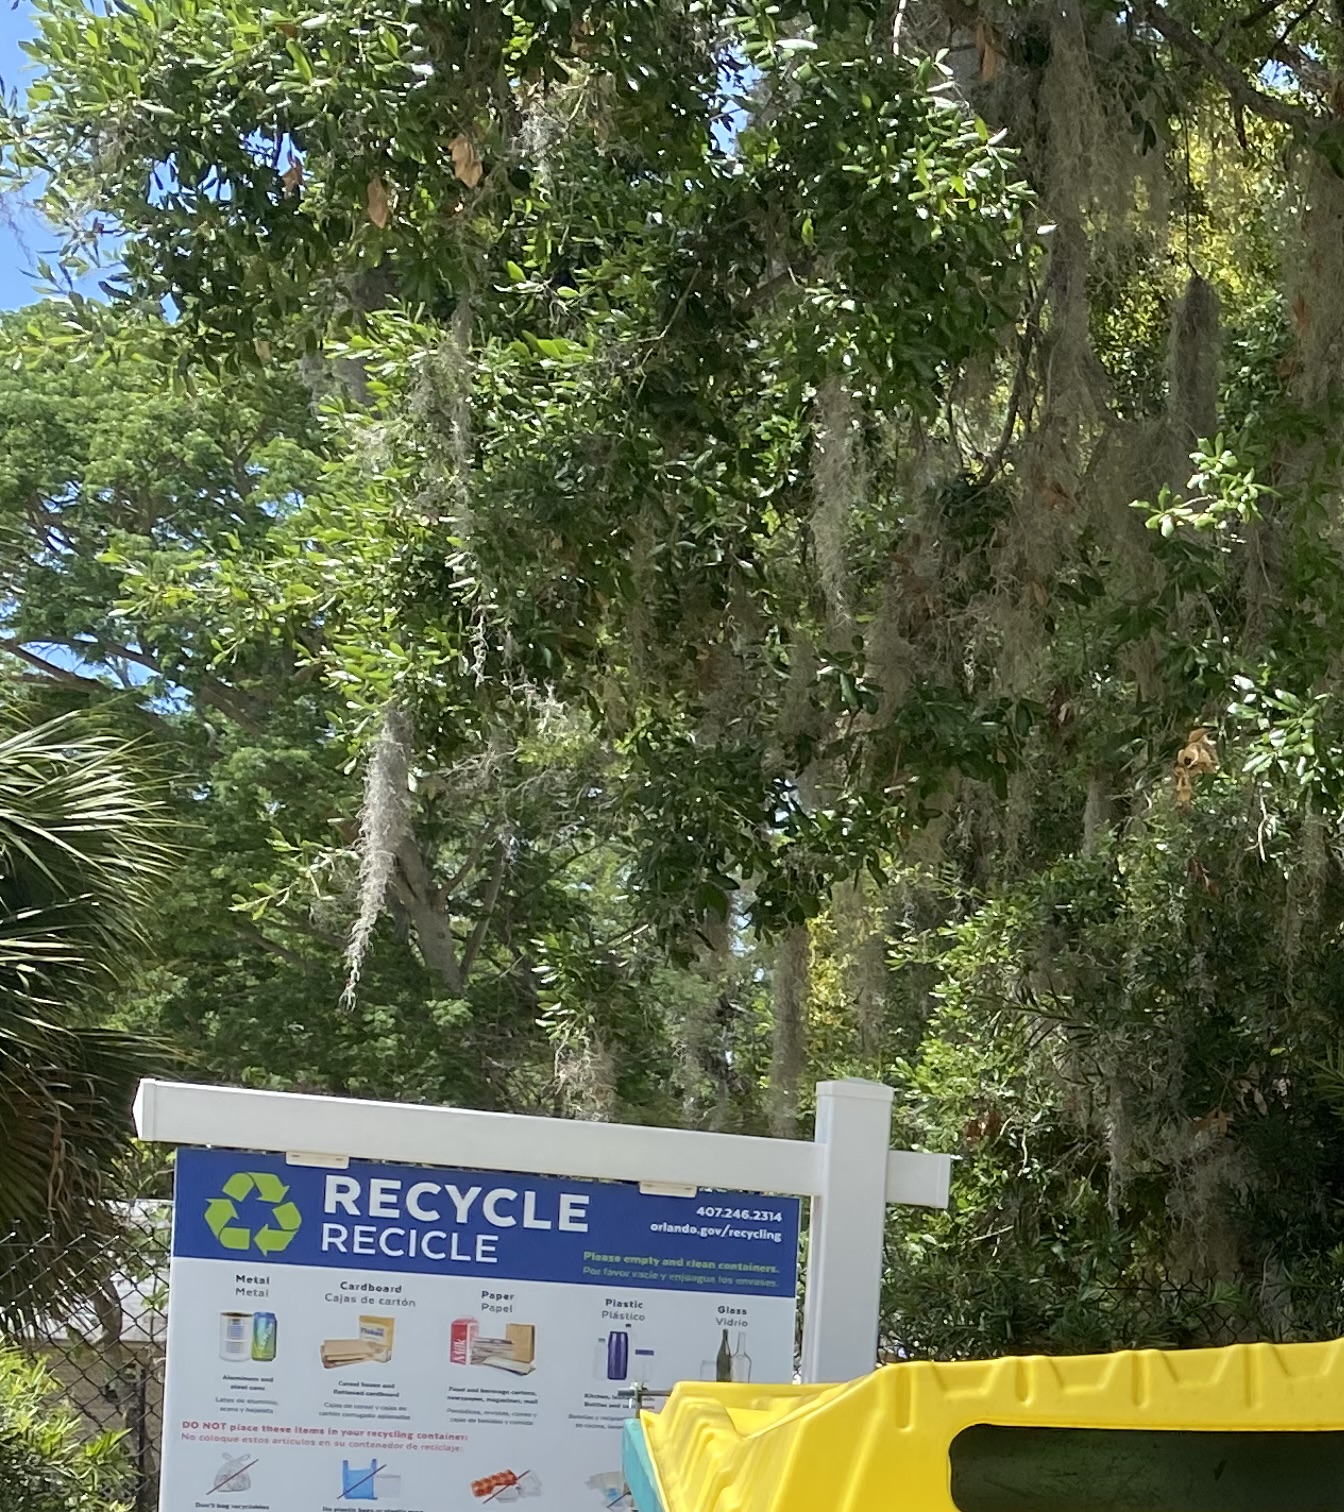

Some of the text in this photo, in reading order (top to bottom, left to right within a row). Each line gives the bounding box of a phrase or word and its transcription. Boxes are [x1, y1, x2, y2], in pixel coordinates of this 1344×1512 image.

[324, 1174, 590, 1232] RECYCLE
[696, 1206, 782, 1222] 407.246.2314
[650, 1221, 782, 1242] orlando.gov/recycling
[321, 1223, 499, 1263] RECICLE
[583, 1251, 780, 1274] Please empty and clean containers.
[235, 1274, 270, 1285] Metal
[235, 1288, 269, 1298] Metal
[340, 1281, 402, 1294] Cardboard
[324, 1292, 416, 1307] Cajas de cartón
[481, 1290, 514, 1303] Paper
[481, 1303, 513, 1314] Papel
[605, 1298, 643, 1309] Plastic
[718, 1305, 747, 1315] Glass
[601, 1310, 645, 1322] Plástico
[715, 1317, 748, 1327] Vidrio
[182, 1420, 199, 1429] DO
[203, 1421, 227, 1431] NOT
[230, 1423, 258, 1434] place
[262, 1425, 291, 1434] these
[295, 1426, 324, 1435] items
[328, 1427, 339, 1436] in
[341, 1429, 364, 1438] your
[367, 1430, 413, 1441] recycling
[181, 1432, 196, 1441] No
[319, 1439, 330, 1447] en
